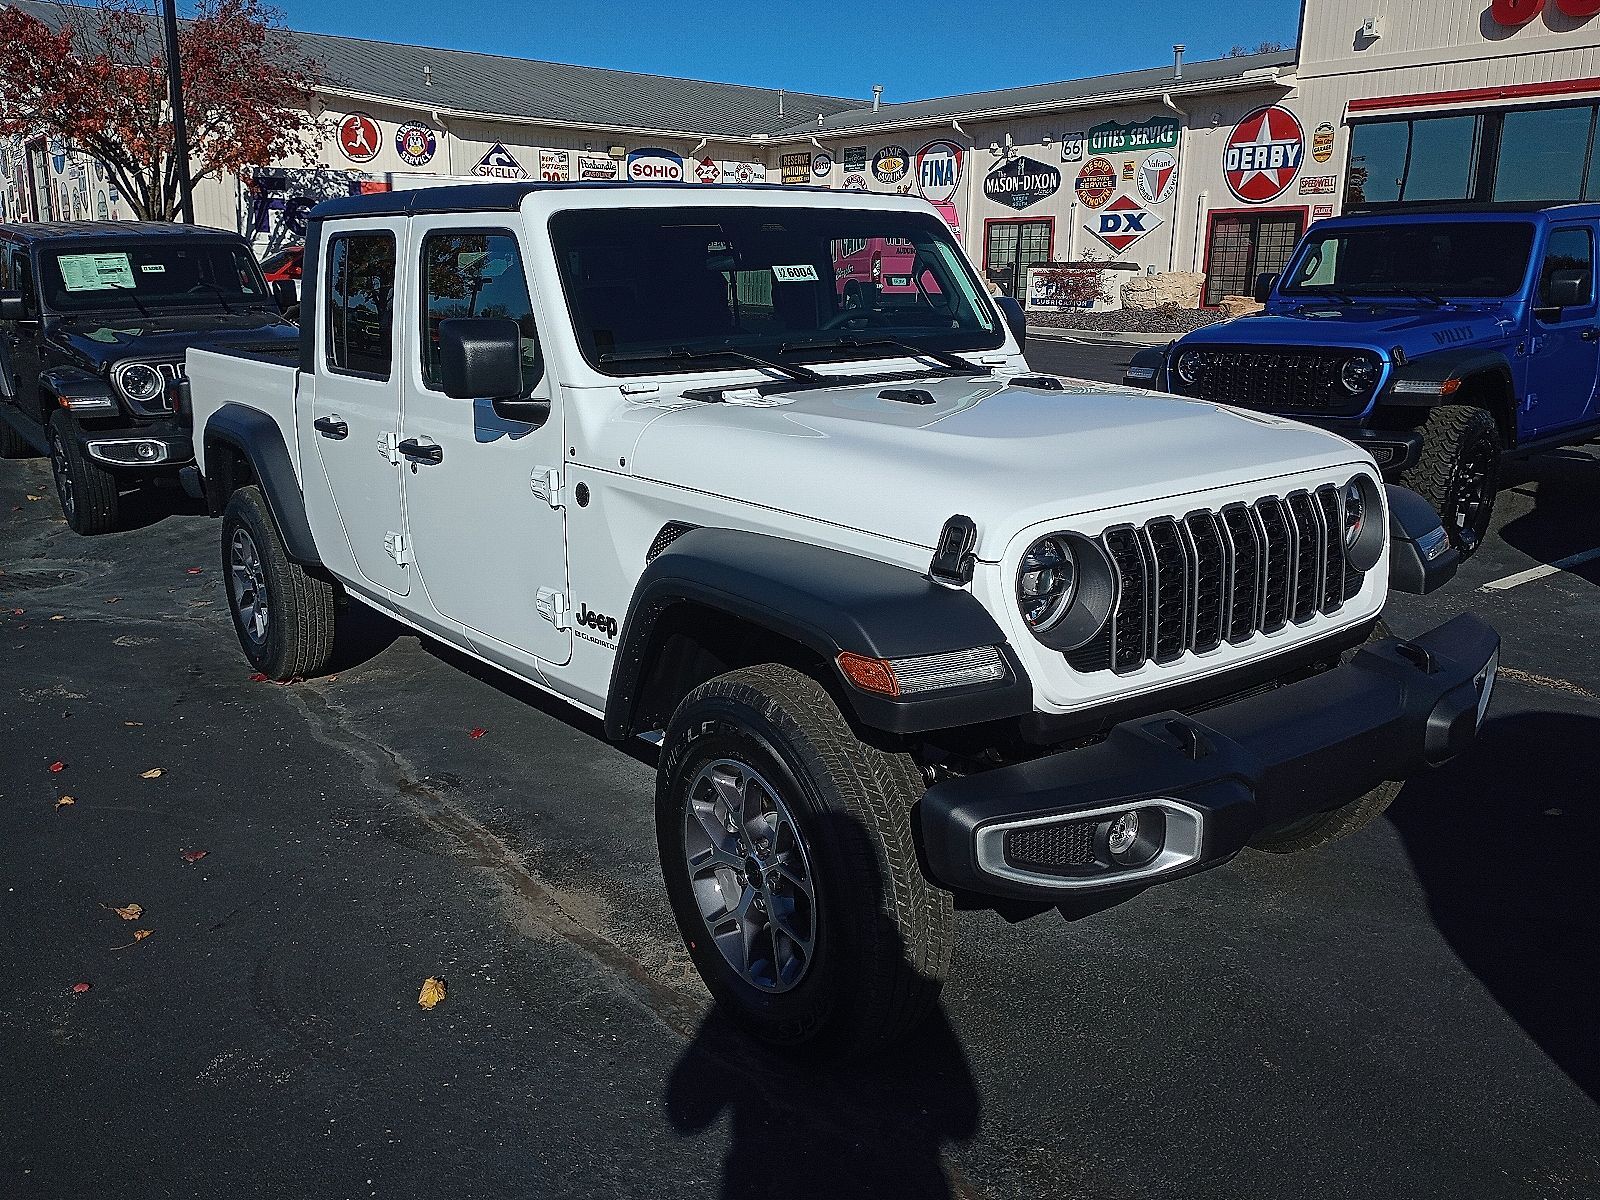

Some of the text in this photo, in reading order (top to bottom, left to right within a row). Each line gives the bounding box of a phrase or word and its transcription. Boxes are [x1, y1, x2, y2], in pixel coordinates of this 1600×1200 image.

[1093, 124, 1174, 149] CITIES SERVICE
[1063, 140, 1081, 155] 66
[783, 154, 809, 166] RESERVE
[1147, 159, 1171, 168] Valiant
[1226, 144, 1300, 171] DERBY
[478, 166, 520, 179] SKELLY
[632, 163, 679, 179] SOHIO
[782, 165, 810, 176] NATIONAL
[921, 158, 955, 188] FINA
[1084, 160, 1110, 174] DESOTO
[986, 172, 1057, 194] MASON-DIXON
[1079, 181, 1113, 189] SERVICE
[1080, 188, 1111, 206] PLYMOUTH
[1098, 212, 1148, 233] DX
[1431, 325, 1474, 345] WILLYS
[575, 602, 618, 640] Jeep
